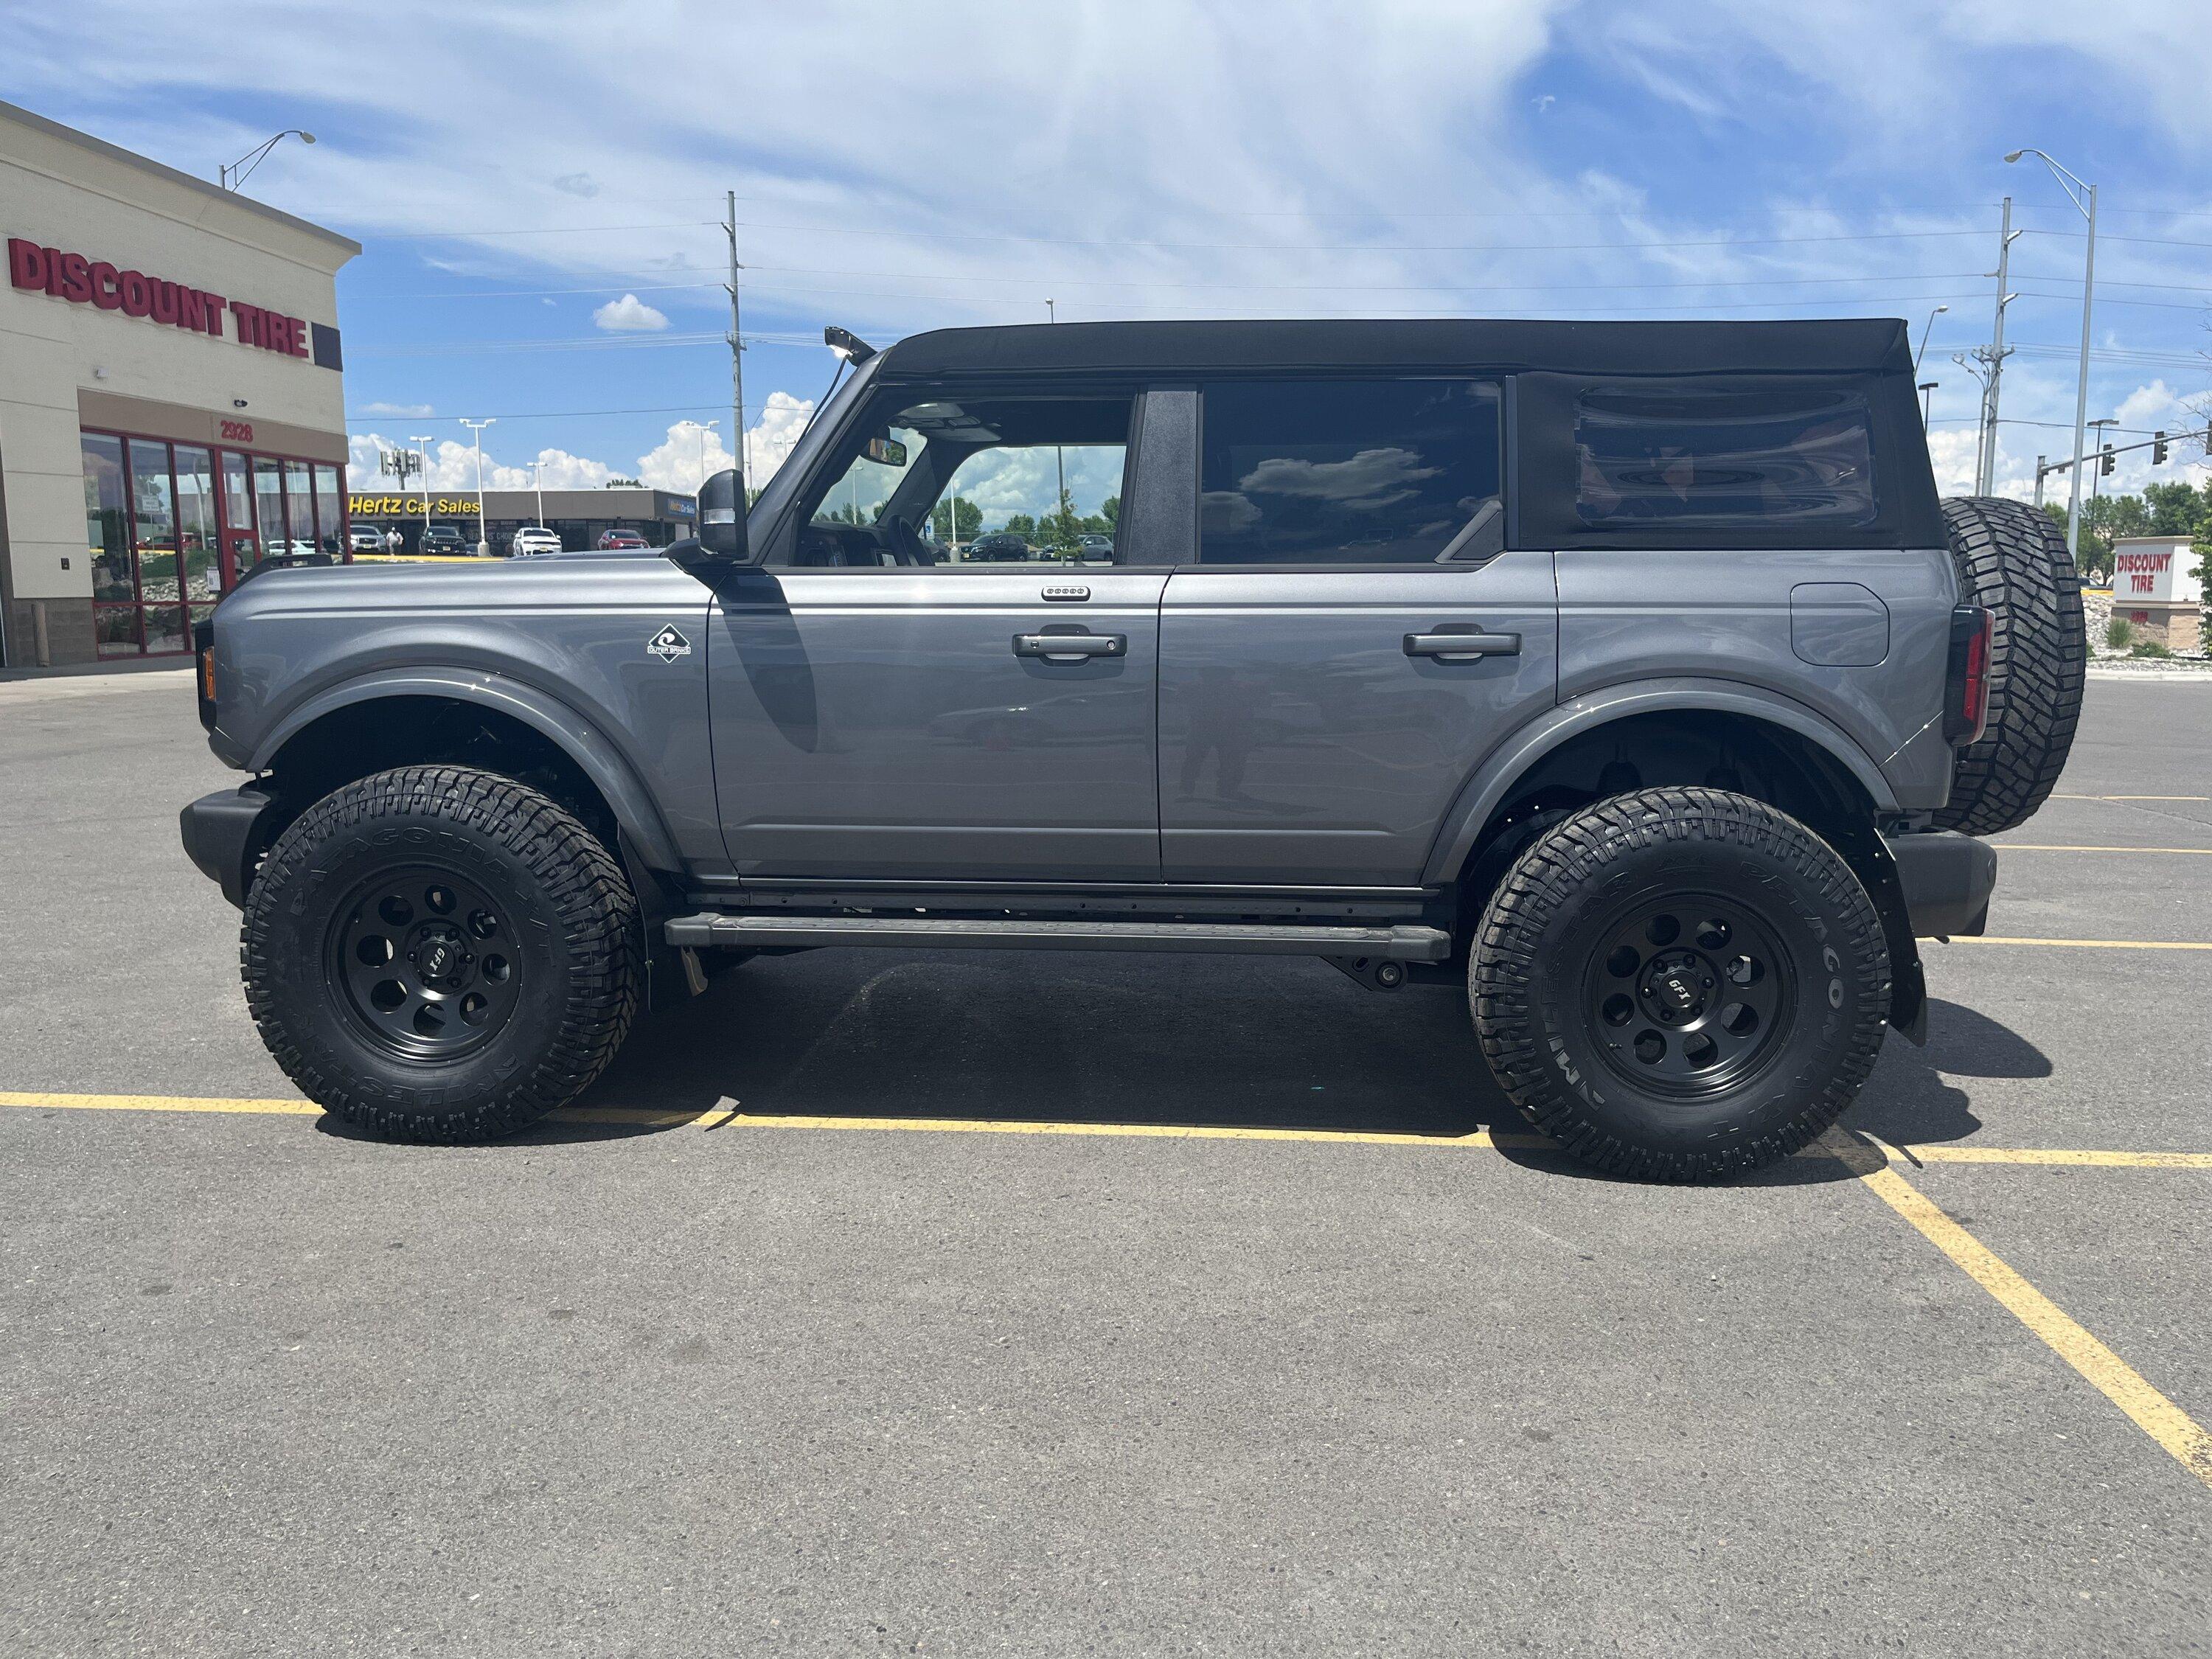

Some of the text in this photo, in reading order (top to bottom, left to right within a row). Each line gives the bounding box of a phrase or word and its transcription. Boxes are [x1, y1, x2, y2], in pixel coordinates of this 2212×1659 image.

[8, 238, 310, 358] DISCOUNT TIRE
[220, 420, 254, 442] 2928
[348, 496, 481, 514] Hertz Car Sales
[2118, 554, 2171, 573] DISCOUNT
[2131, 575, 2154, 594] TIRE
[290, 826, 511, 917] PATAGONIA
[429, 947, 446, 972] GFX
[1668, 979, 1691, 1001] GFX
